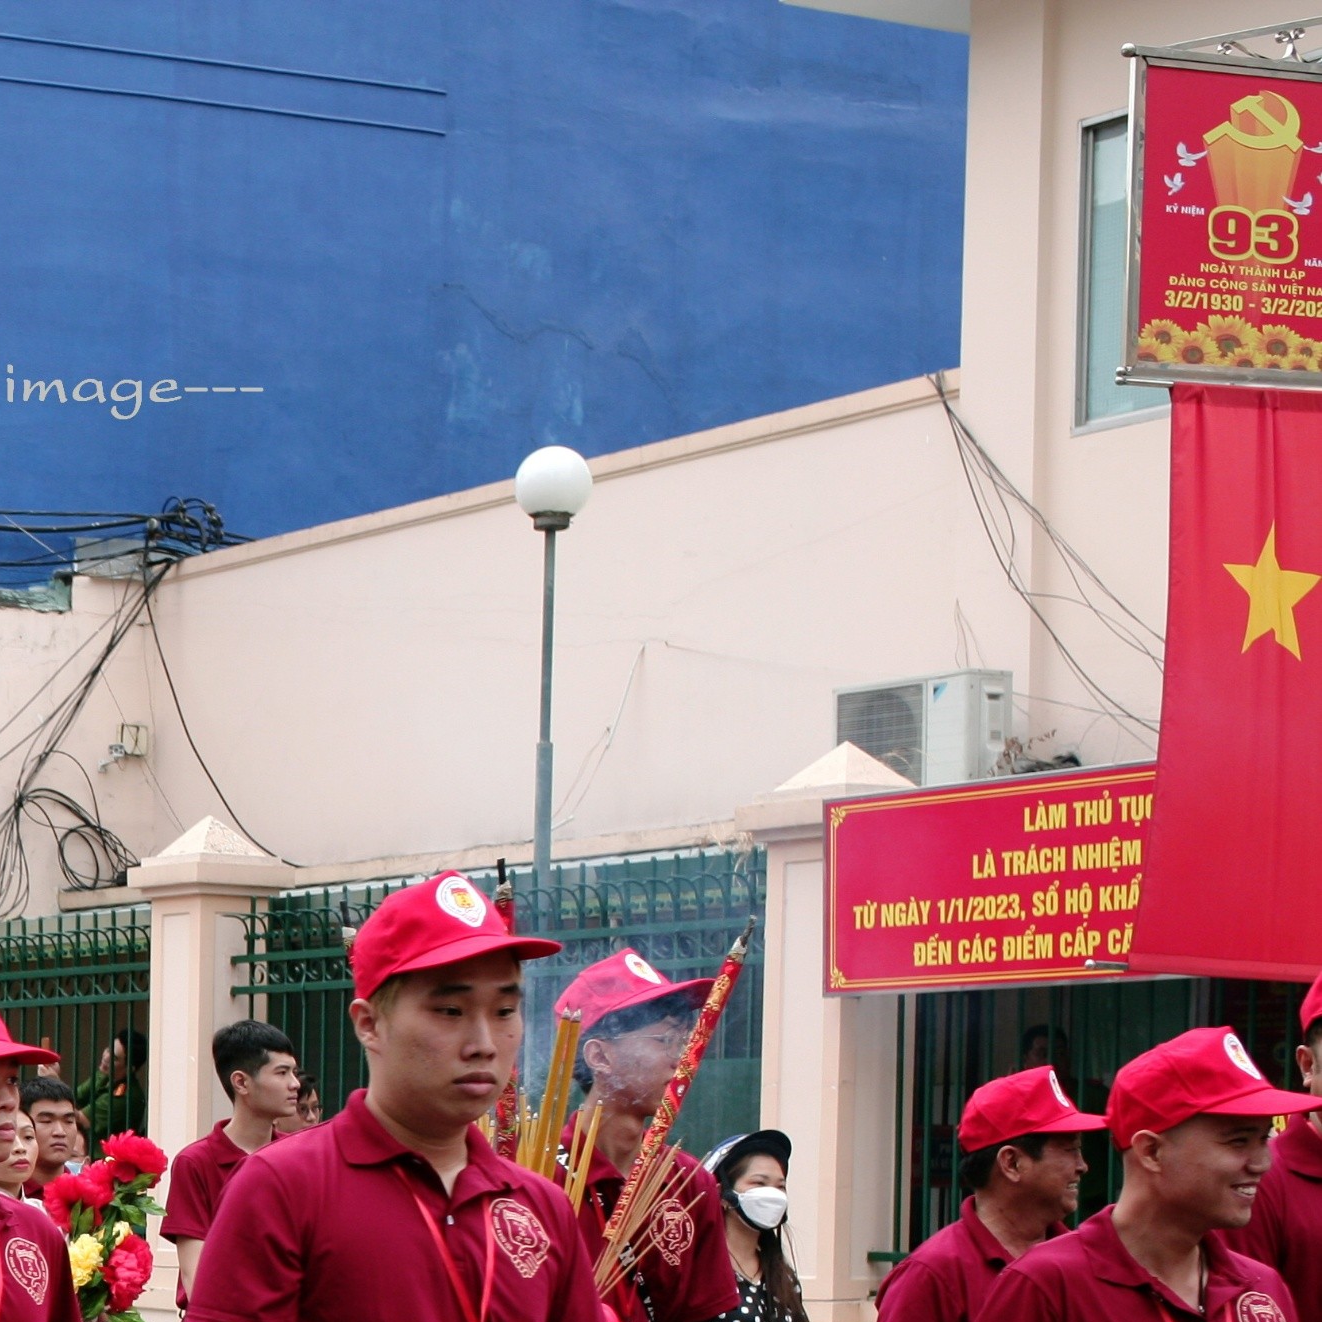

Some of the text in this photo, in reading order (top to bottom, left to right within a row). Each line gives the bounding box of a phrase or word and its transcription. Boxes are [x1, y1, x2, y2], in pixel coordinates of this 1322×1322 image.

[1165, 203, 1205, 216] KỶ NIỆM
[1208, 204, 1299, 264] 93
[1168, 273, 1322, 297] ĐẢNG CỘNG SẢN VIỆT NA
[1200, 262, 1306, 283] NGÀY THÀNH LẬP
[1164, 290, 1243, 312] 3/2/1930
[1261, 297, 1322, 319] 3/2/202
[1023, 800, 1067, 832] LÀM
[1073, 790, 1112, 826] THỦ
[972, 836, 1141, 879] LÀ TRÁCH NHIỆM
[853, 873, 1143, 930] TỪ NGÀY 1/1/2023, SỔ HỘ KHẨ
[913, 921, 1133, 967] ĐẾN CÁC ĐIỂM CẤP CĂ
